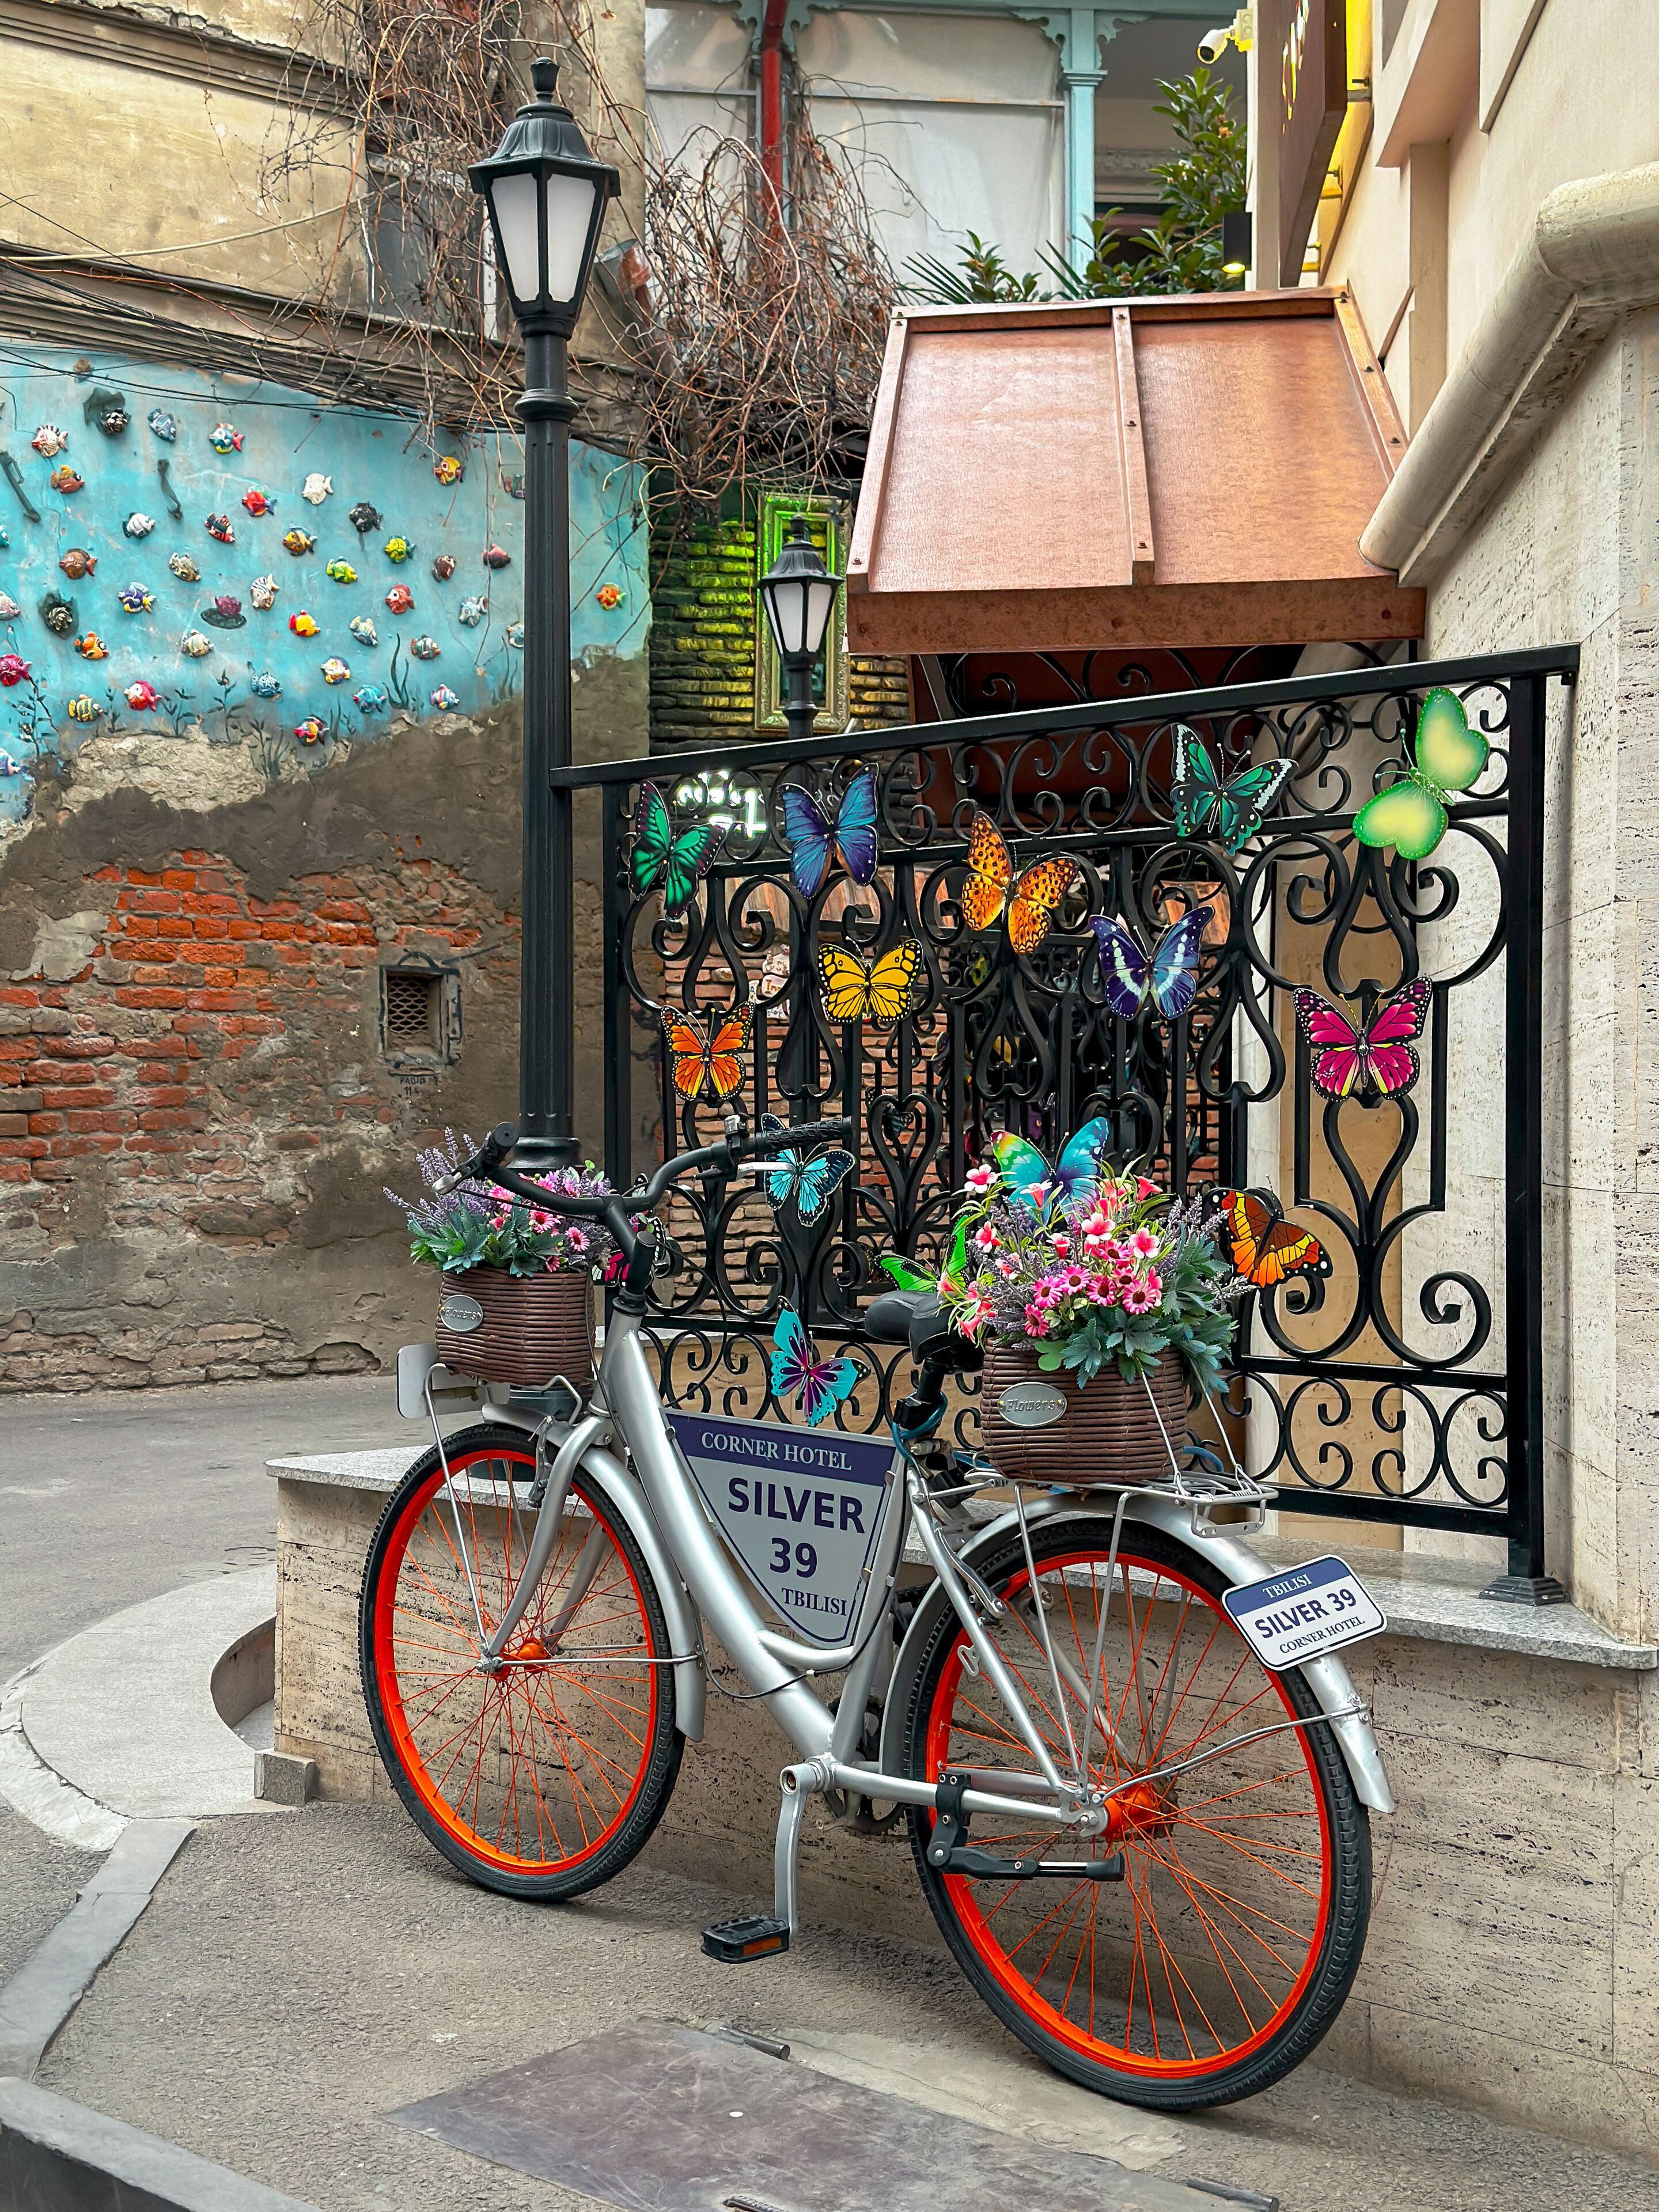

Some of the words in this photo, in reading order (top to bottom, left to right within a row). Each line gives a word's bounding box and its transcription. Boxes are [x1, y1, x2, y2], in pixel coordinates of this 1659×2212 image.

[1006, 1399, 1056, 1412] Flowers
[702, 1432, 780, 1459] CORNER
[784, 1445, 852, 1471] HOTEL
[728, 1477, 865, 1534] SILVER
[769, 1537, 818, 1578] 39
[781, 1587, 847, 1616] TBILISI
[1262, 1574, 1313, 1599] TBILISI
[1255, 1599, 1330, 1639] SILVER
[1327, 1588, 1357, 1612] 39
[1279, 1630, 1326, 1654] CORNER
[1324, 1616, 1365, 1636] HOTEL
